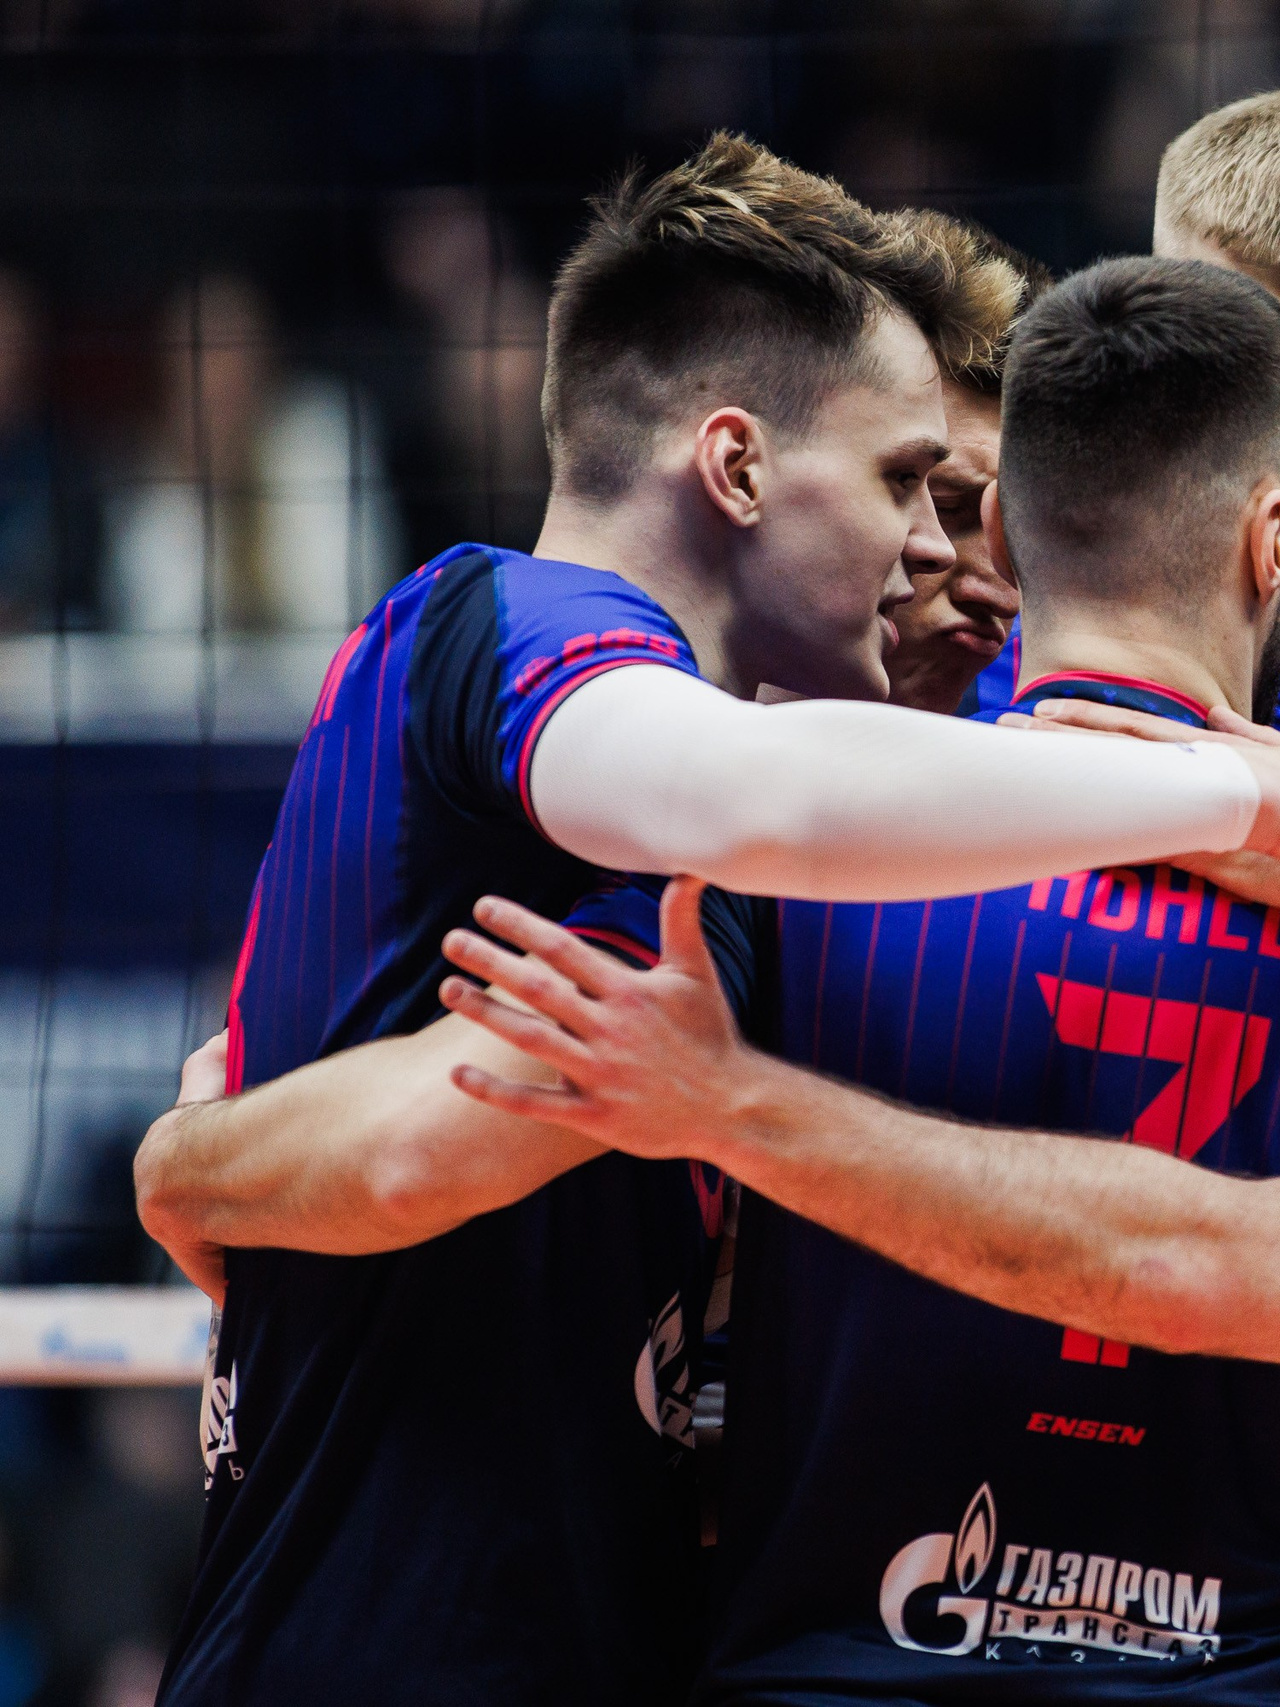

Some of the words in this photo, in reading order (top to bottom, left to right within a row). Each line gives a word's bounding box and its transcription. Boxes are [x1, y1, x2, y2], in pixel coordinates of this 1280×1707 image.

[1026, 1411, 1147, 1447] ENSEN
[995, 1543, 1222, 1636] ГАЗПРОМ
[996, 1608, 1216, 1656] ТРАНСГАЗ
